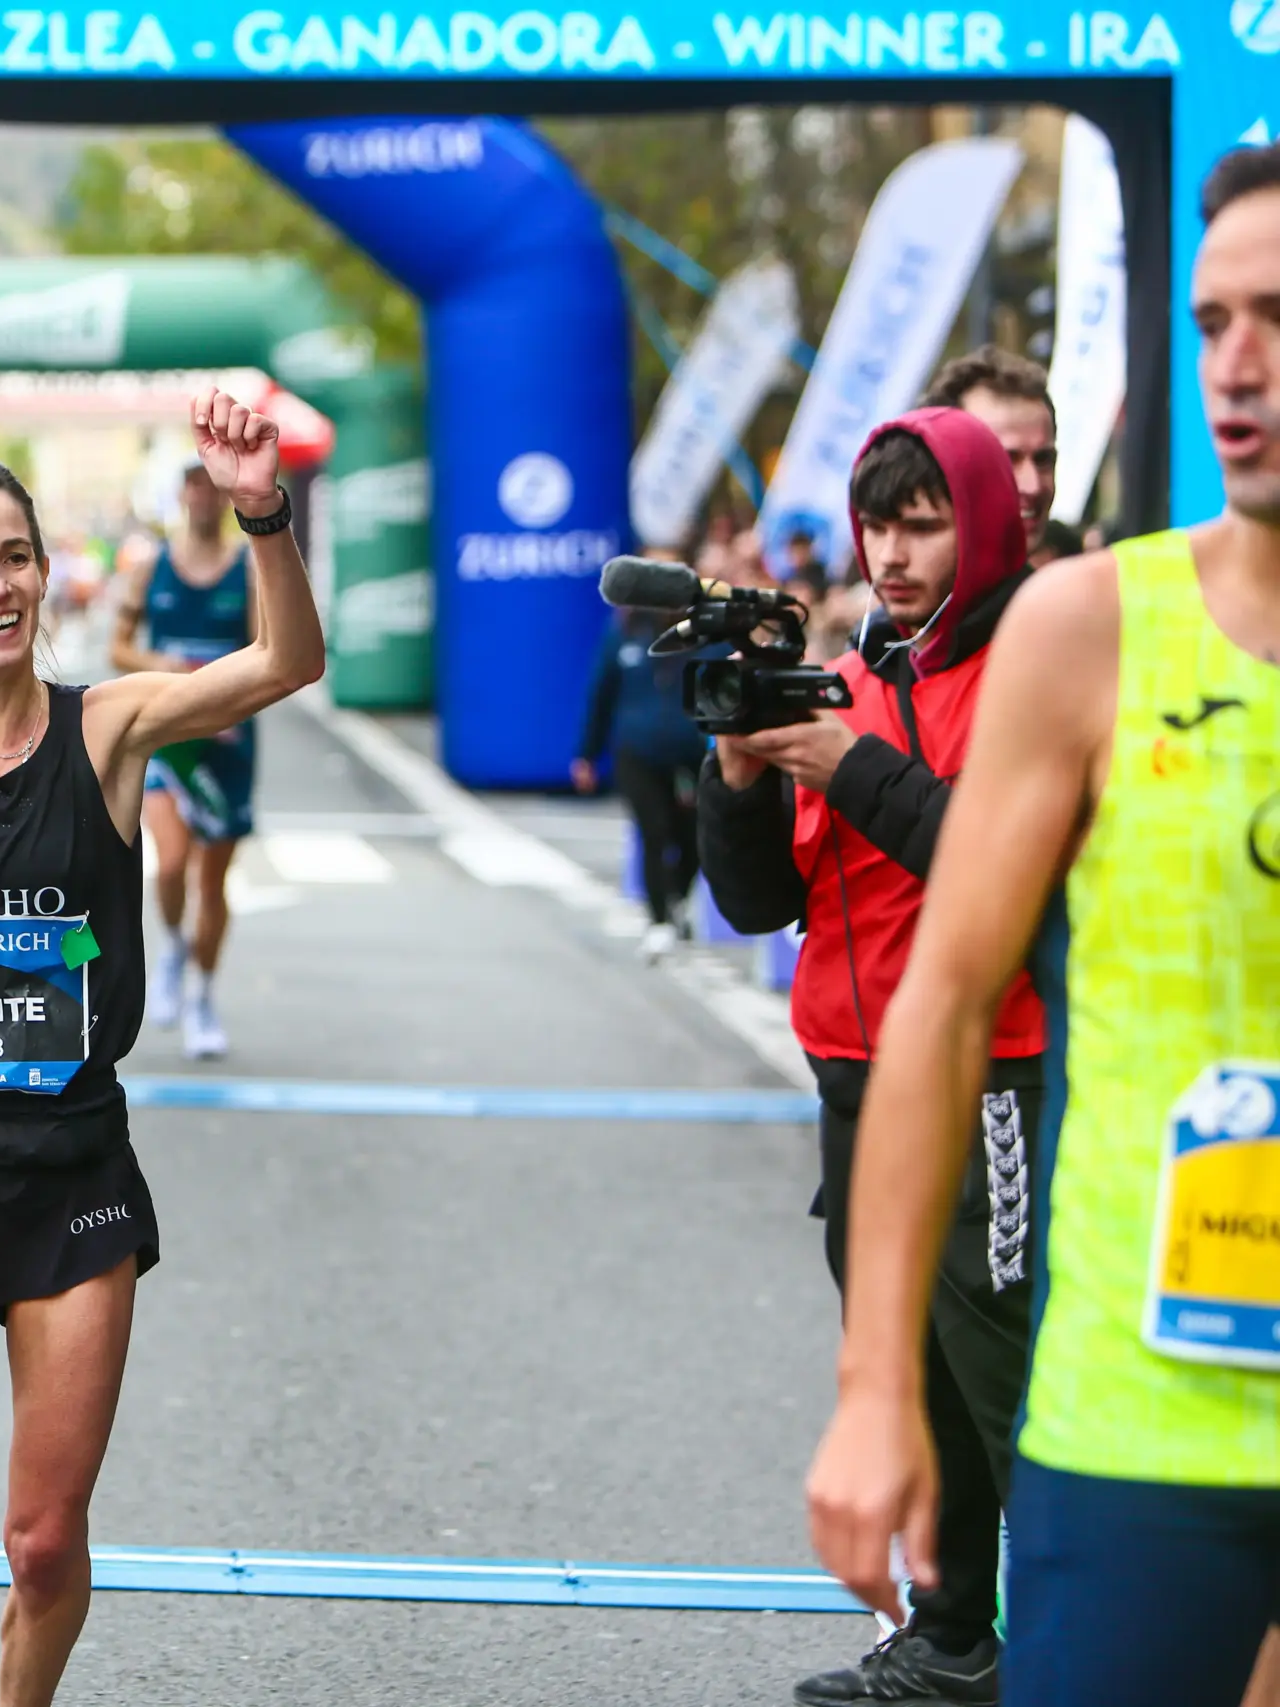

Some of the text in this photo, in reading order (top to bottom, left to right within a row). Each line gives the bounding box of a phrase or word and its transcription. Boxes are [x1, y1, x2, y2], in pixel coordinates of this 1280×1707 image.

[233, 9, 655, 73] GANADORA
[713, 11, 1007, 70] WINNER
[1069, 11, 1181, 69] IRA
[304, 122, 484, 180] ZURICH
[456, 529, 616, 581] ZURICH
